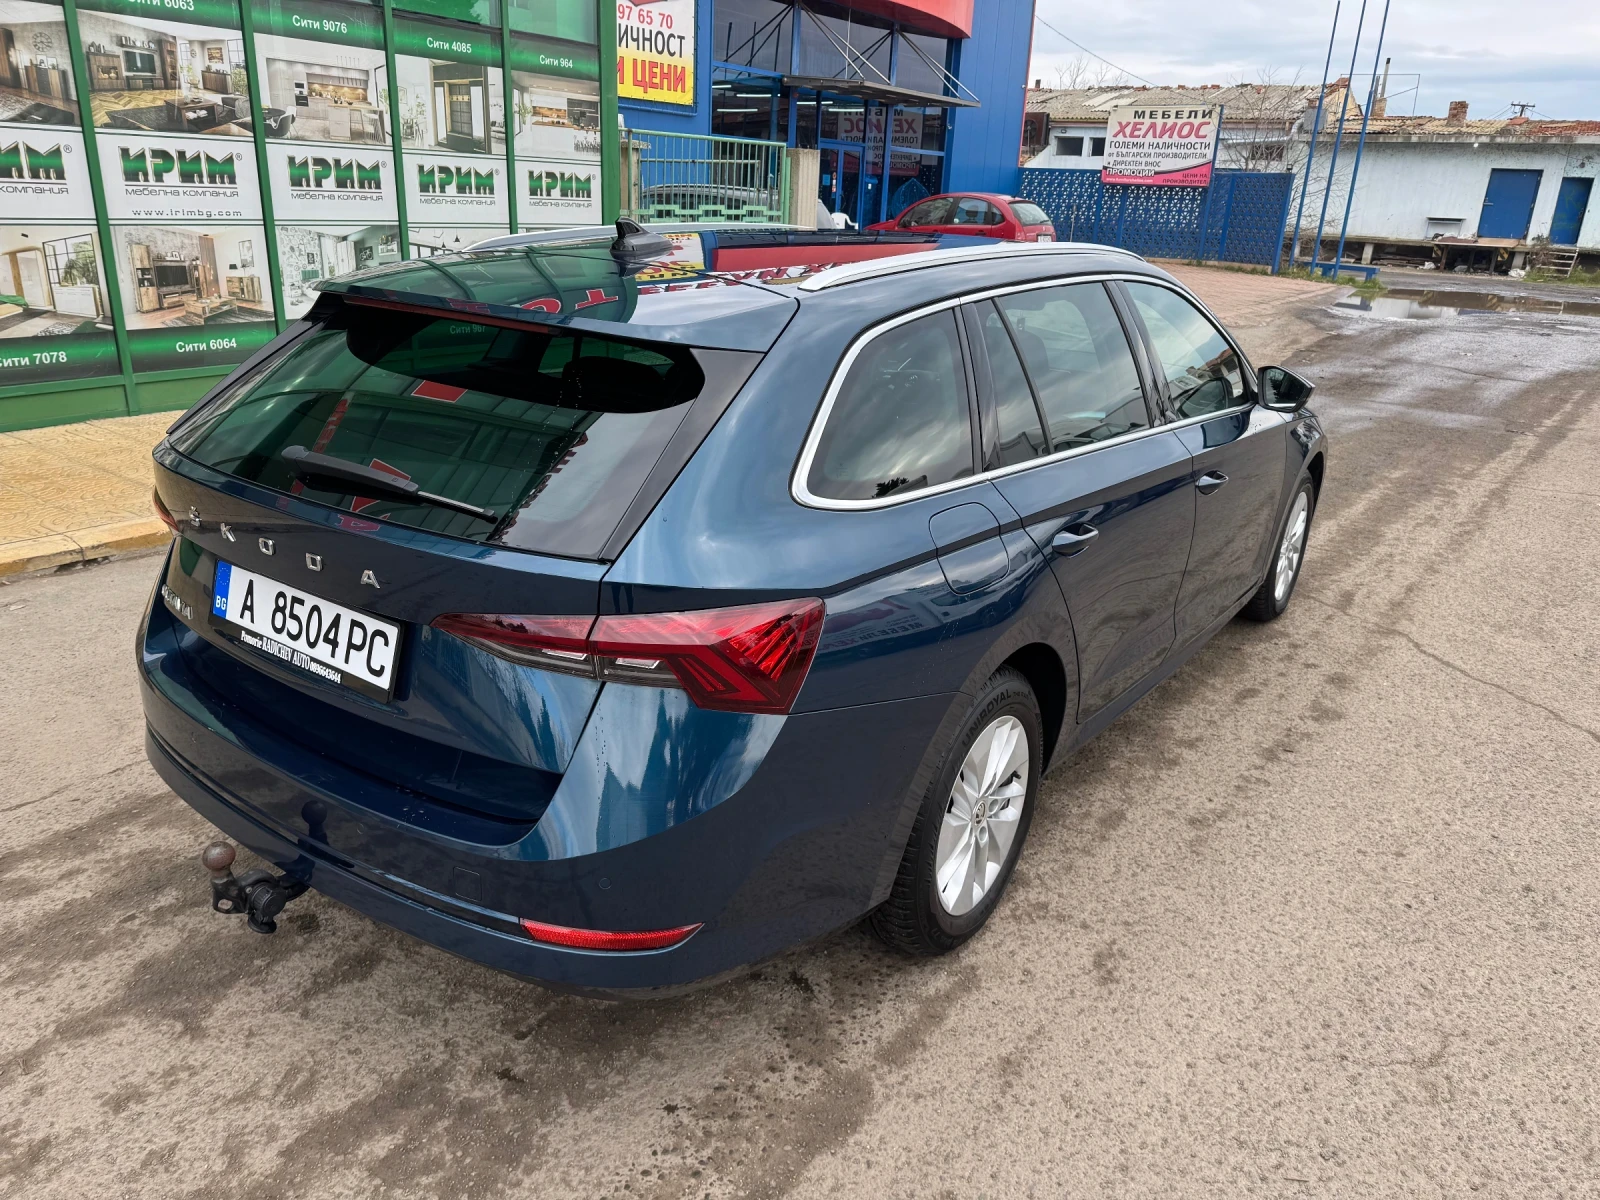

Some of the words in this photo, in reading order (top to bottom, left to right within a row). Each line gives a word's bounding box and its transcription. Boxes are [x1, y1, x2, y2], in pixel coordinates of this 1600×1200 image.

[164, 0, 195, 11] 6063
[292, 14, 320, 30] Сити
[322, 19, 348, 34] 9076
[617, 3, 633, 21] 97
[638, 8, 653, 26] 65
[658, 12, 673, 30] 70
[426, 37, 449, 50] Сити
[451, 41, 472, 54] 4085
[539, 54, 558, 67] Сити
[560, 58, 573, 69] 964
[632, 58, 686, 94] ЦЕНИ
[1133, 109, 1213, 120] МЕБЕЛИ
[1112, 121, 1211, 139] ХЕЛИОС
[1109, 140, 1145, 150] ГОЛЕМИ
[1148, 141, 1211, 151] НАЛИЧНОСТИ
[1115, 151, 1152, 159] БЪЛГАРСКИ
[118, 145, 238, 185] ИРИМ
[1112, 159, 1143, 167] ДИРЕКТЕН
[1144, 160, 1162, 168] ВНОС
[287, 154, 382, 190] ИРИМ
[416, 163, 495, 195] ИРИМ
[1106, 168, 1155, 178] ПРОМОЦИИ
[527, 169, 592, 198] ИРИМ
[125, 187, 180, 197] мебелна
[182, 189, 239, 198] компания
[291, 191, 336, 200] мебелна
[337, 193, 384, 201] компания
[420, 197, 457, 205] мебелна
[458, 198, 496, 206] компания
[132, 209, 242, 218] www.irimbg.com
[175, 341, 207, 353] Сити
[209, 337, 237, 349] 6064
[0, 356, 30, 368] ити
[32, 350, 68, 365] 7078
[215, 595, 227, 611] BG
[240, 630, 263, 649] Pomorie
[262, 636, 293, 662] RADICHEV
[292, 650, 311, 670] AUTO
[962, 688, 1012, 748] UNIROYAL
